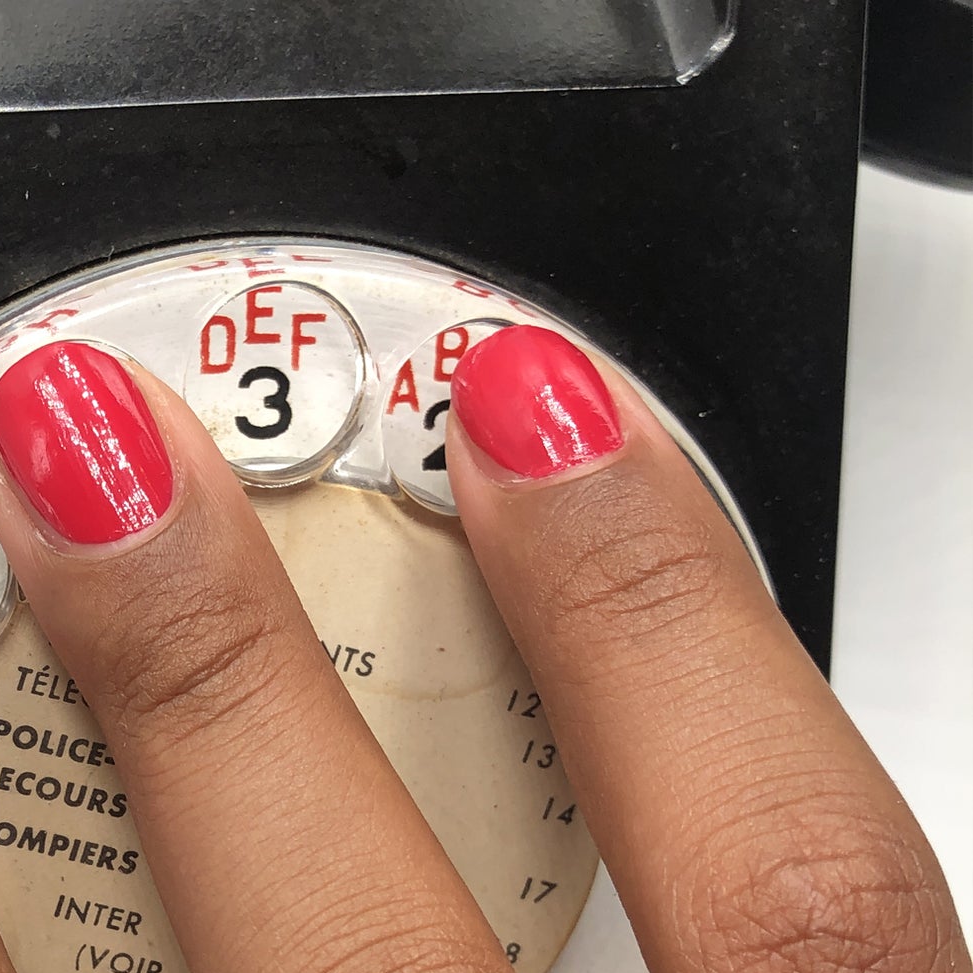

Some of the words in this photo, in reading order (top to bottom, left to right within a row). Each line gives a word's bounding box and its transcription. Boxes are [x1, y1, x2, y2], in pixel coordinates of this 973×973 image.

[235, 366, 293, 440] 3
[506, 689, 542, 718] 12
[522, 740, 557, 769] 13
[542, 797, 577, 826] 14
[519, 876, 558, 904] 17
[53, 894, 143, 936] INTER
